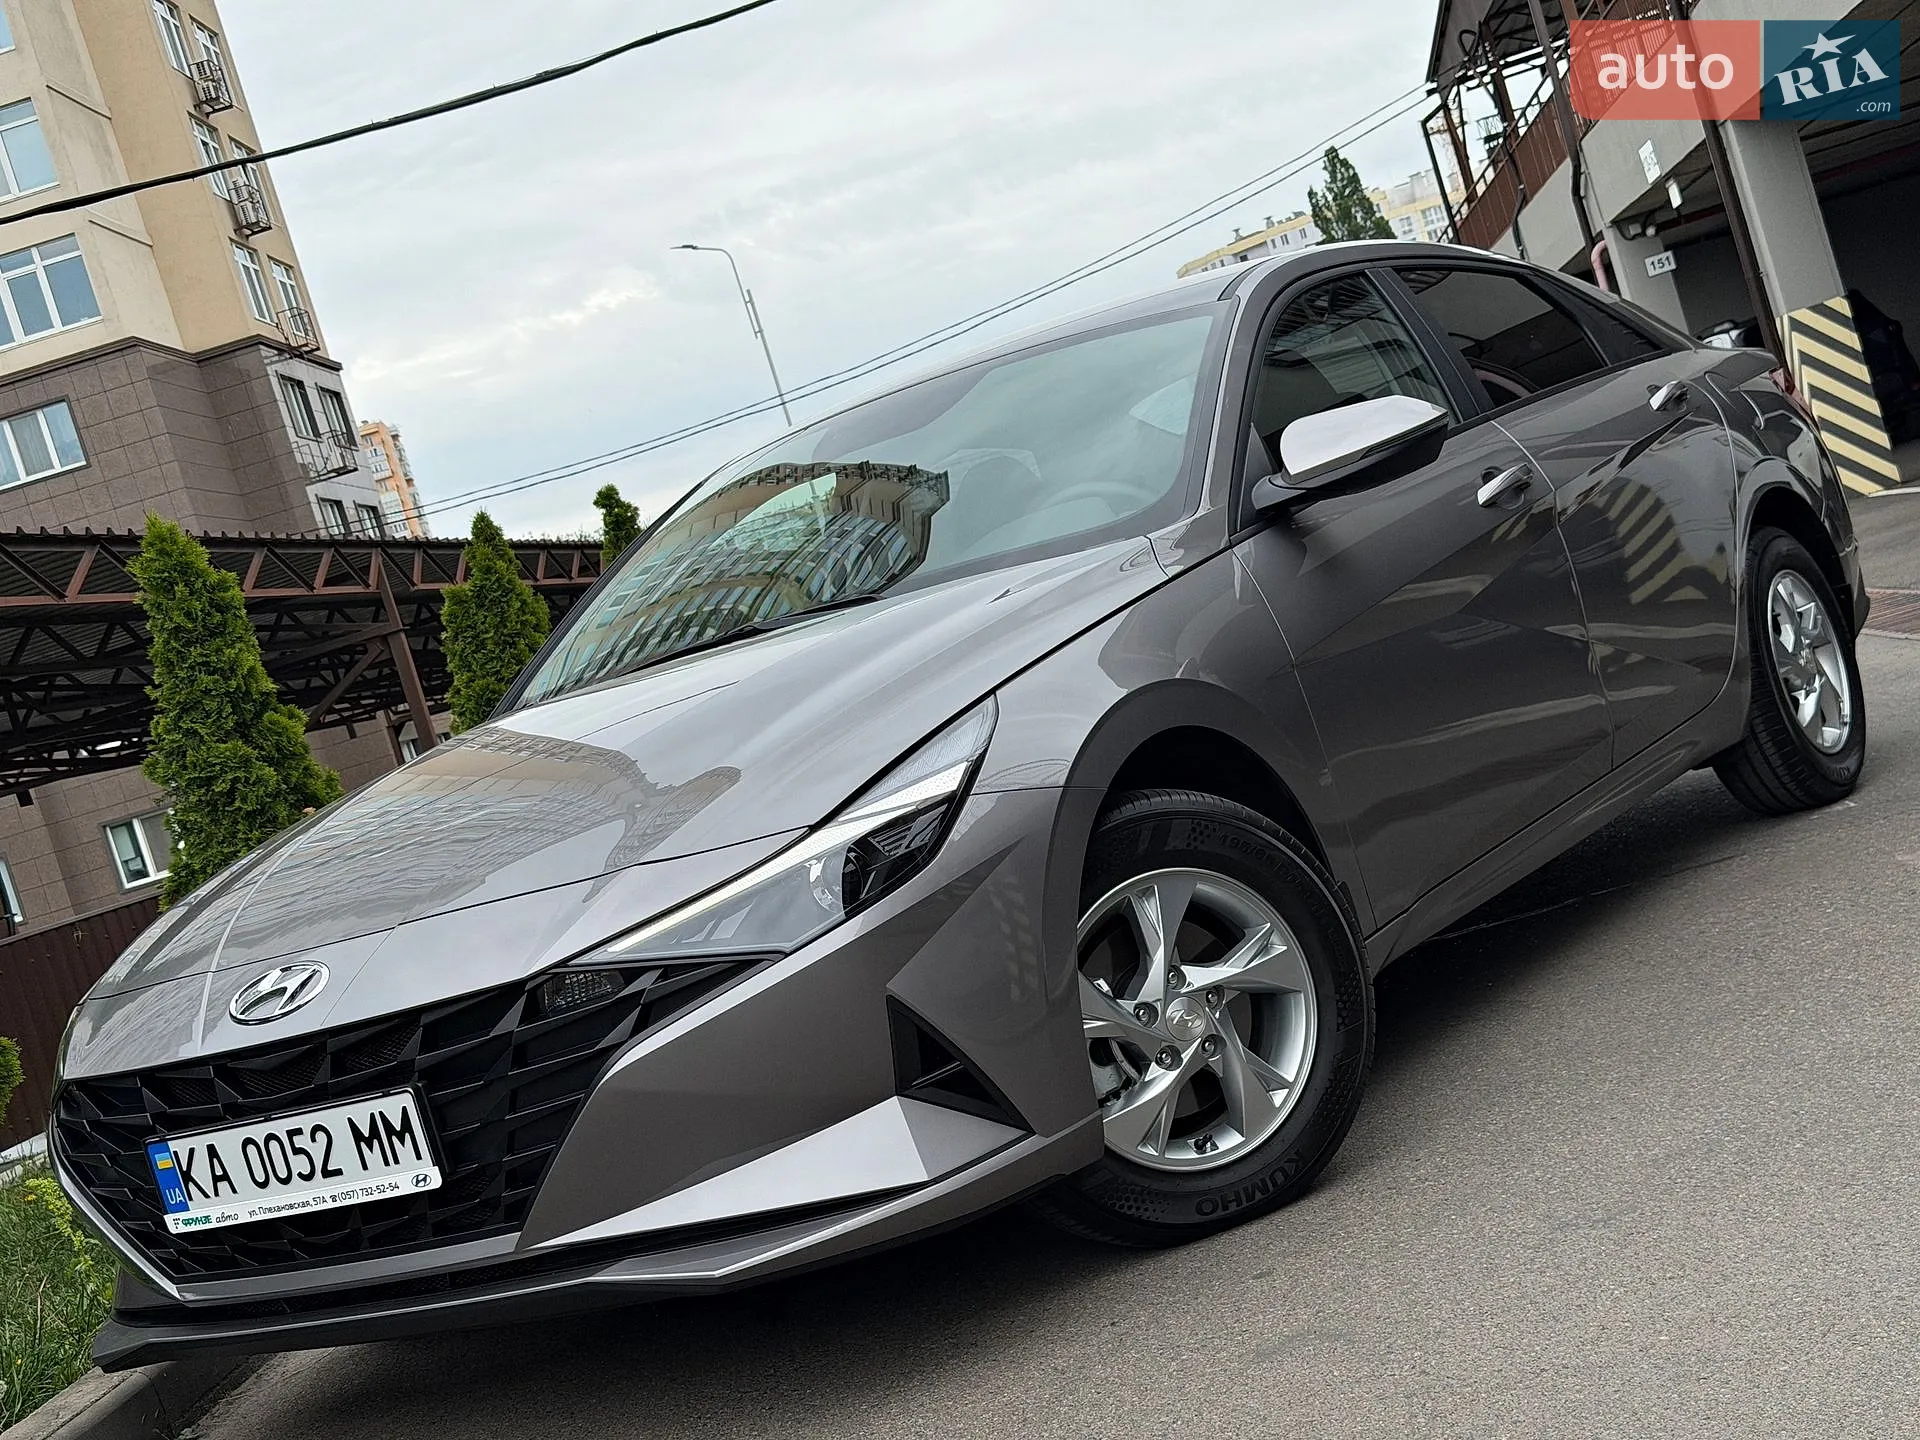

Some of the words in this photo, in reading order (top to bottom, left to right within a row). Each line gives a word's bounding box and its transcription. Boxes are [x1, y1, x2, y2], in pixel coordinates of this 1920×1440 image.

[1649, 256, 1673, 272] 151
[173, 1143, 238, 1202] KA
[241, 1123, 344, 1190] 0052
[346, 1105, 423, 1171] MM
[1194, 1148, 1304, 1218] KUMHO
[165, 1187, 186, 1205] UA
[181, 1214, 213, 1227] ФРУНЗЕ
[215, 1211, 240, 1224] авто
